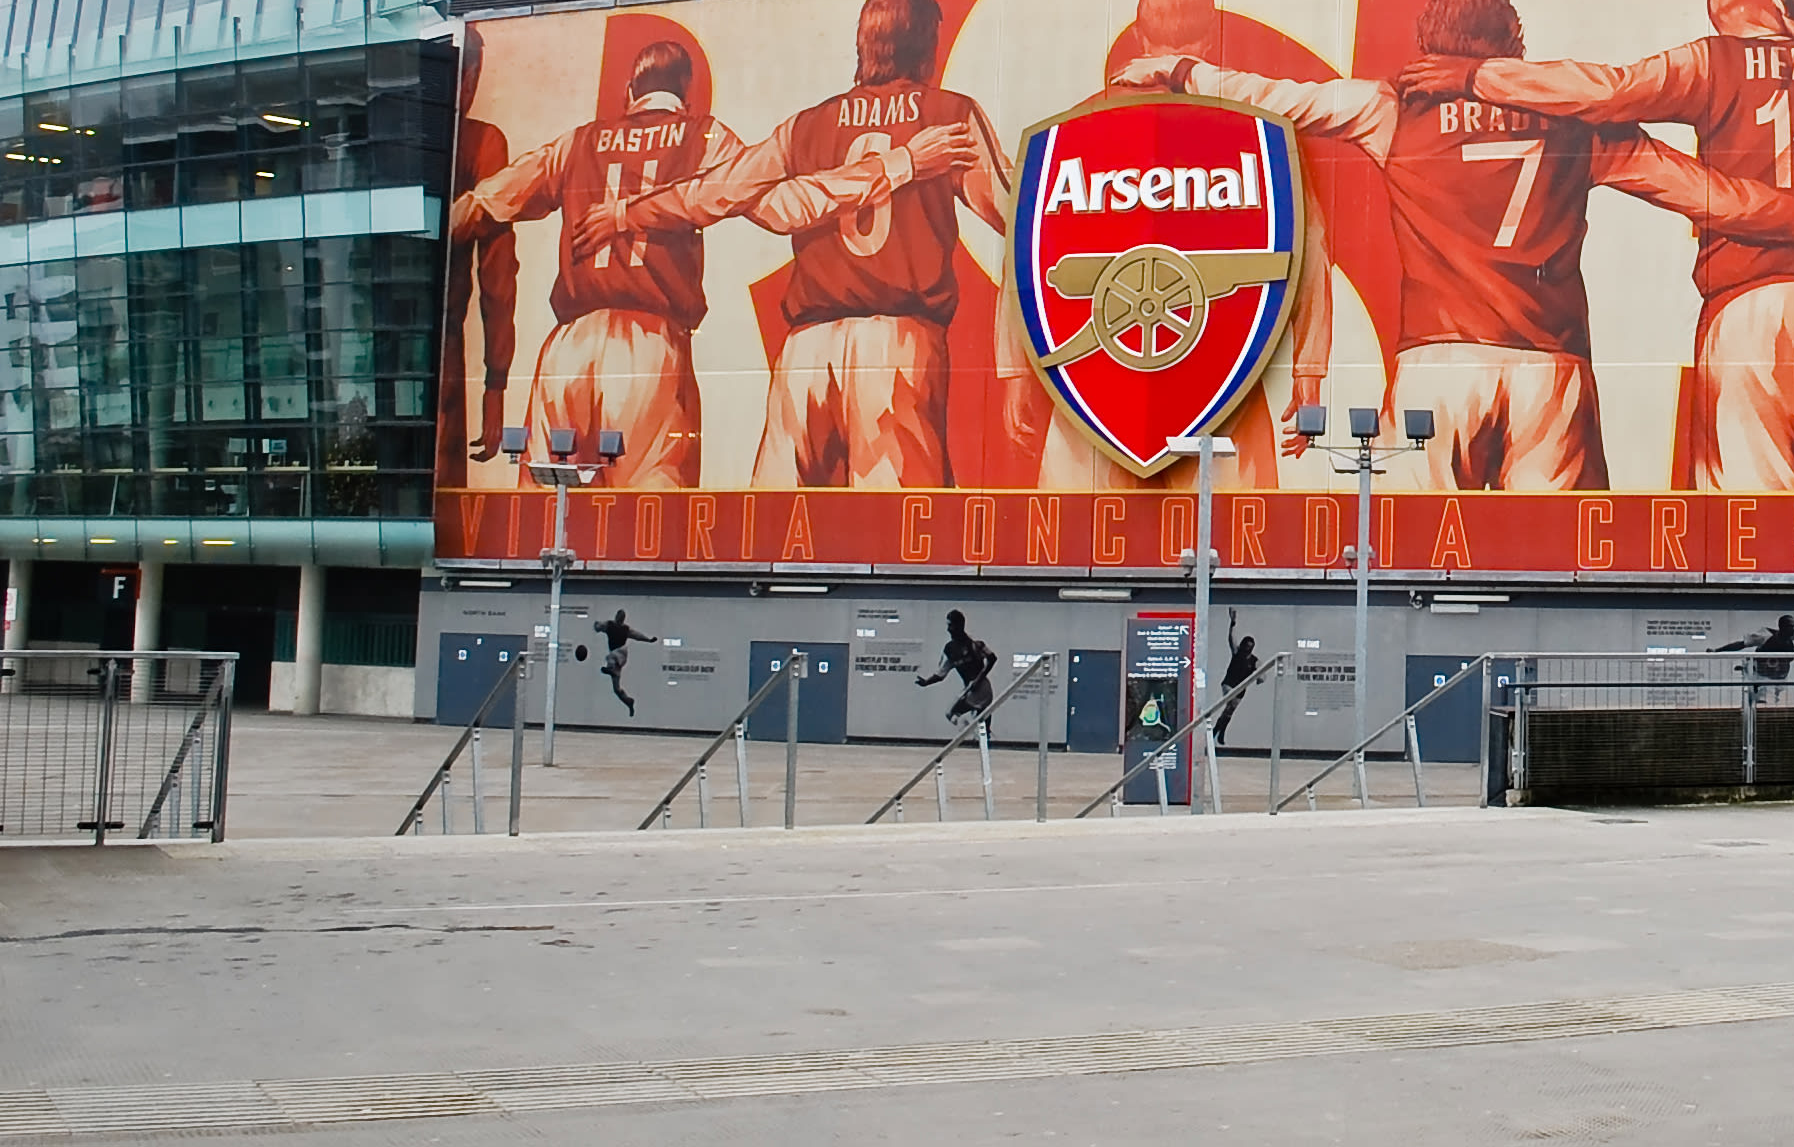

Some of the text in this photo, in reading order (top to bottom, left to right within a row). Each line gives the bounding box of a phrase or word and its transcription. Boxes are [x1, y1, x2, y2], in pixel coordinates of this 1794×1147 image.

[597, 122, 686, 153] BASTIN
[838, 91, 922, 127] ADAMS
[594, 159, 659, 269] 11
[1044, 151, 1262, 215] Arsenal
[1461, 139, 1546, 248] 7
[460, 494, 814, 560] VICTORIA
[901, 495, 1472, 568] CONCORDIA
[113, 576, 126, 599] F
